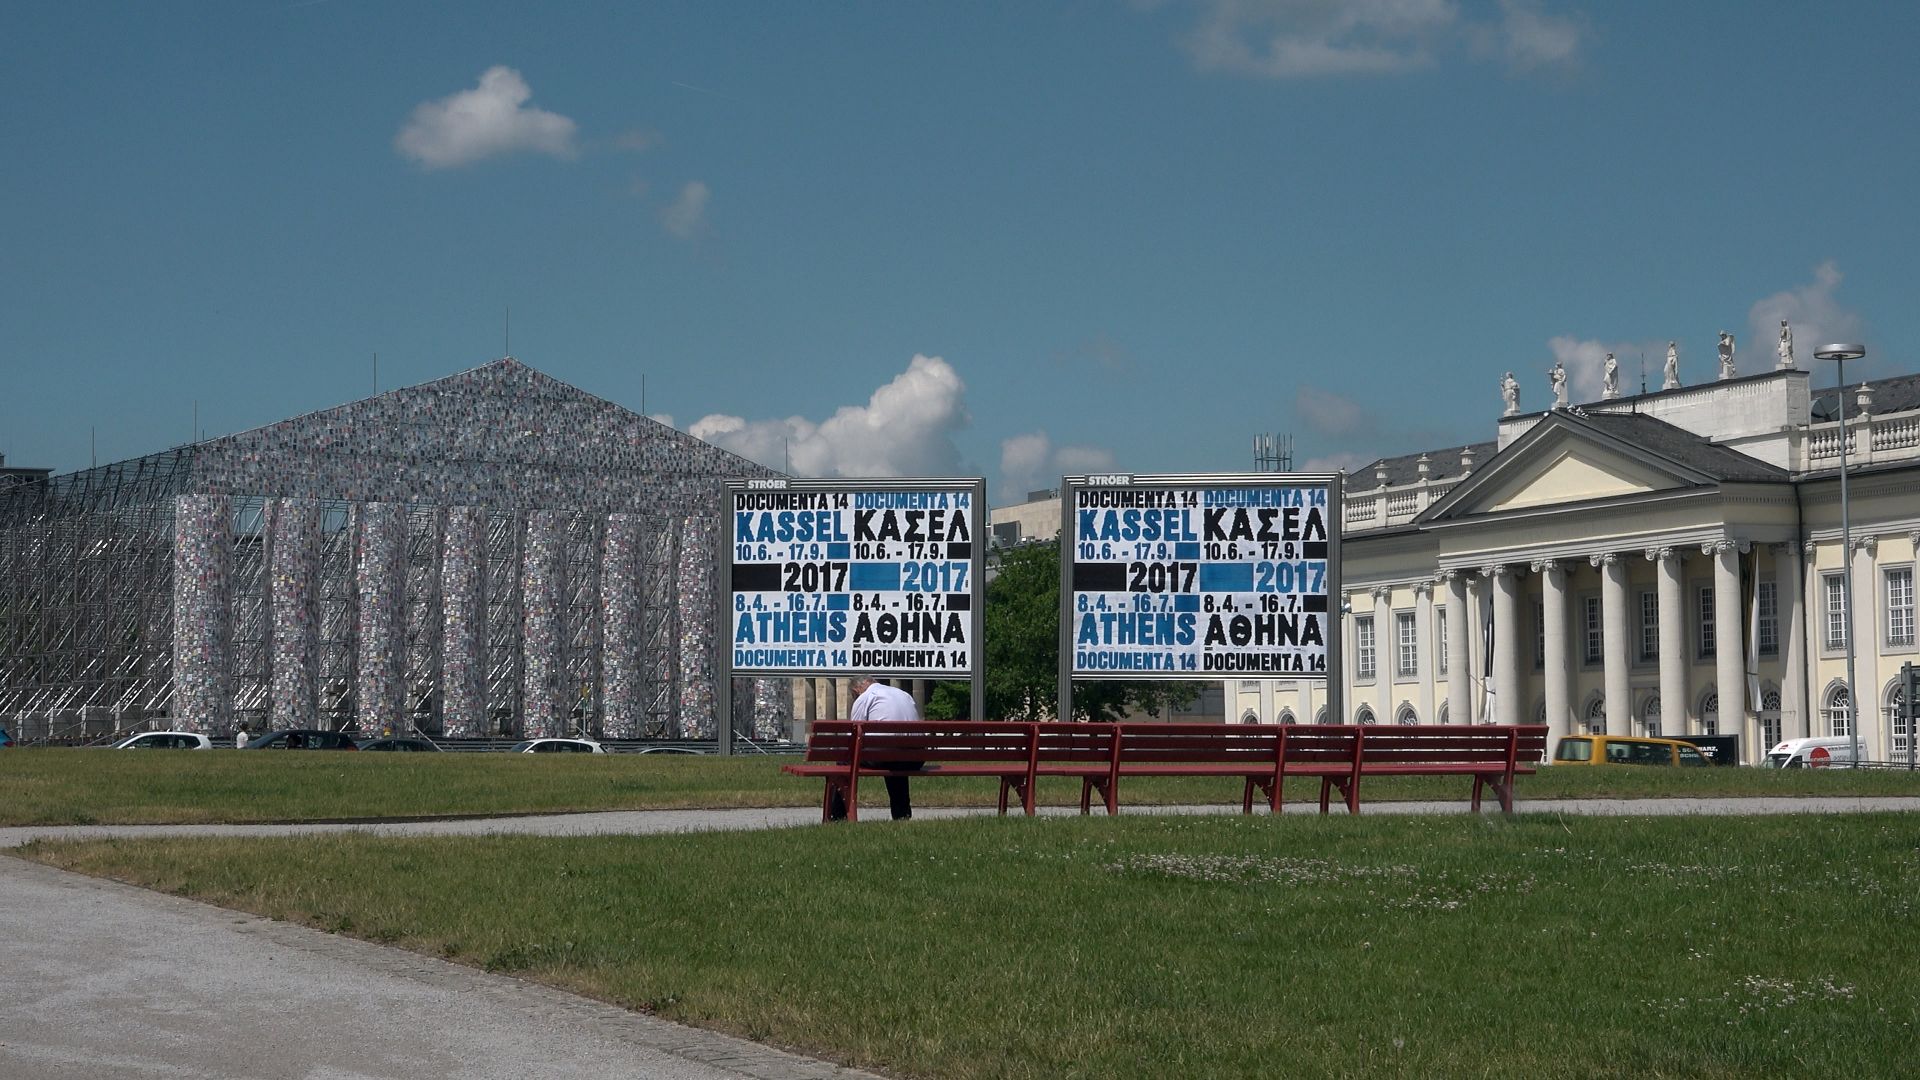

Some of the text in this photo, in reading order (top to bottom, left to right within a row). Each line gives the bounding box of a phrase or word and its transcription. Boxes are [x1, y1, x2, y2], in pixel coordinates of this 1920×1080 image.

[748, 480, 786, 488] STRÖER
[1089, 476, 1129, 485] STRÖER
[736, 493, 849, 510] DOCUMENTA 14
[855, 493, 969, 509] DOCUMENTA 14
[1078, 490, 1199, 509] DOCUMENTA 14
[1203, 489, 1326, 508] DOCUMENTA 14
[737, 511, 848, 543] KASSEL
[854, 509, 969, 542] ΚΑΣΕΛ
[1079, 508, 1197, 542] KASSEL
[1204, 507, 1326, 542] ΚΑΣΕΛ
[736, 544, 771, 561] 10.6.
[789, 544, 823, 560] 17.9.
[854, 543, 890, 559] 10.6.
[908, 543, 943, 559] 17.9.
[1079, 542, 1116, 560] 10.6.
[1135, 543, 1171, 560] 17.9.
[1204, 543, 1242, 560] 10.6.
[1261, 542, 1299, 559] 17.9.
[784, 561, 848, 592] 2017
[903, 561, 968, 592] 2017
[1129, 562, 1197, 593] 2017
[1256, 561, 1326, 593] 2017
[736, 594, 767, 611] 8.4.
[787, 593, 825, 611] 16.7.
[853, 593, 885, 611] 8.4.
[906, 593, 944, 611] 16.7.
[1078, 594, 1111, 612] 8.4.
[1133, 594, 1173, 612] 16.7.
[1204, 595, 1238, 613] 8.4.
[1260, 594, 1301, 613] 16.7.
[736, 611, 847, 644] ATHENS
[853, 611, 965, 643] ΑΘΗΝΑ
[1078, 612, 1196, 646] ATHENS
[1204, 613, 1323, 646] ΑΘΗΝΑ
[735, 649, 847, 667] DOCUMENTA 14
[852, 650, 966, 668] DOCUMENTA 14
[1077, 651, 1196, 670] DOCUMENTA 14
[1204, 653, 1325, 672] DOCUMENTA 14
